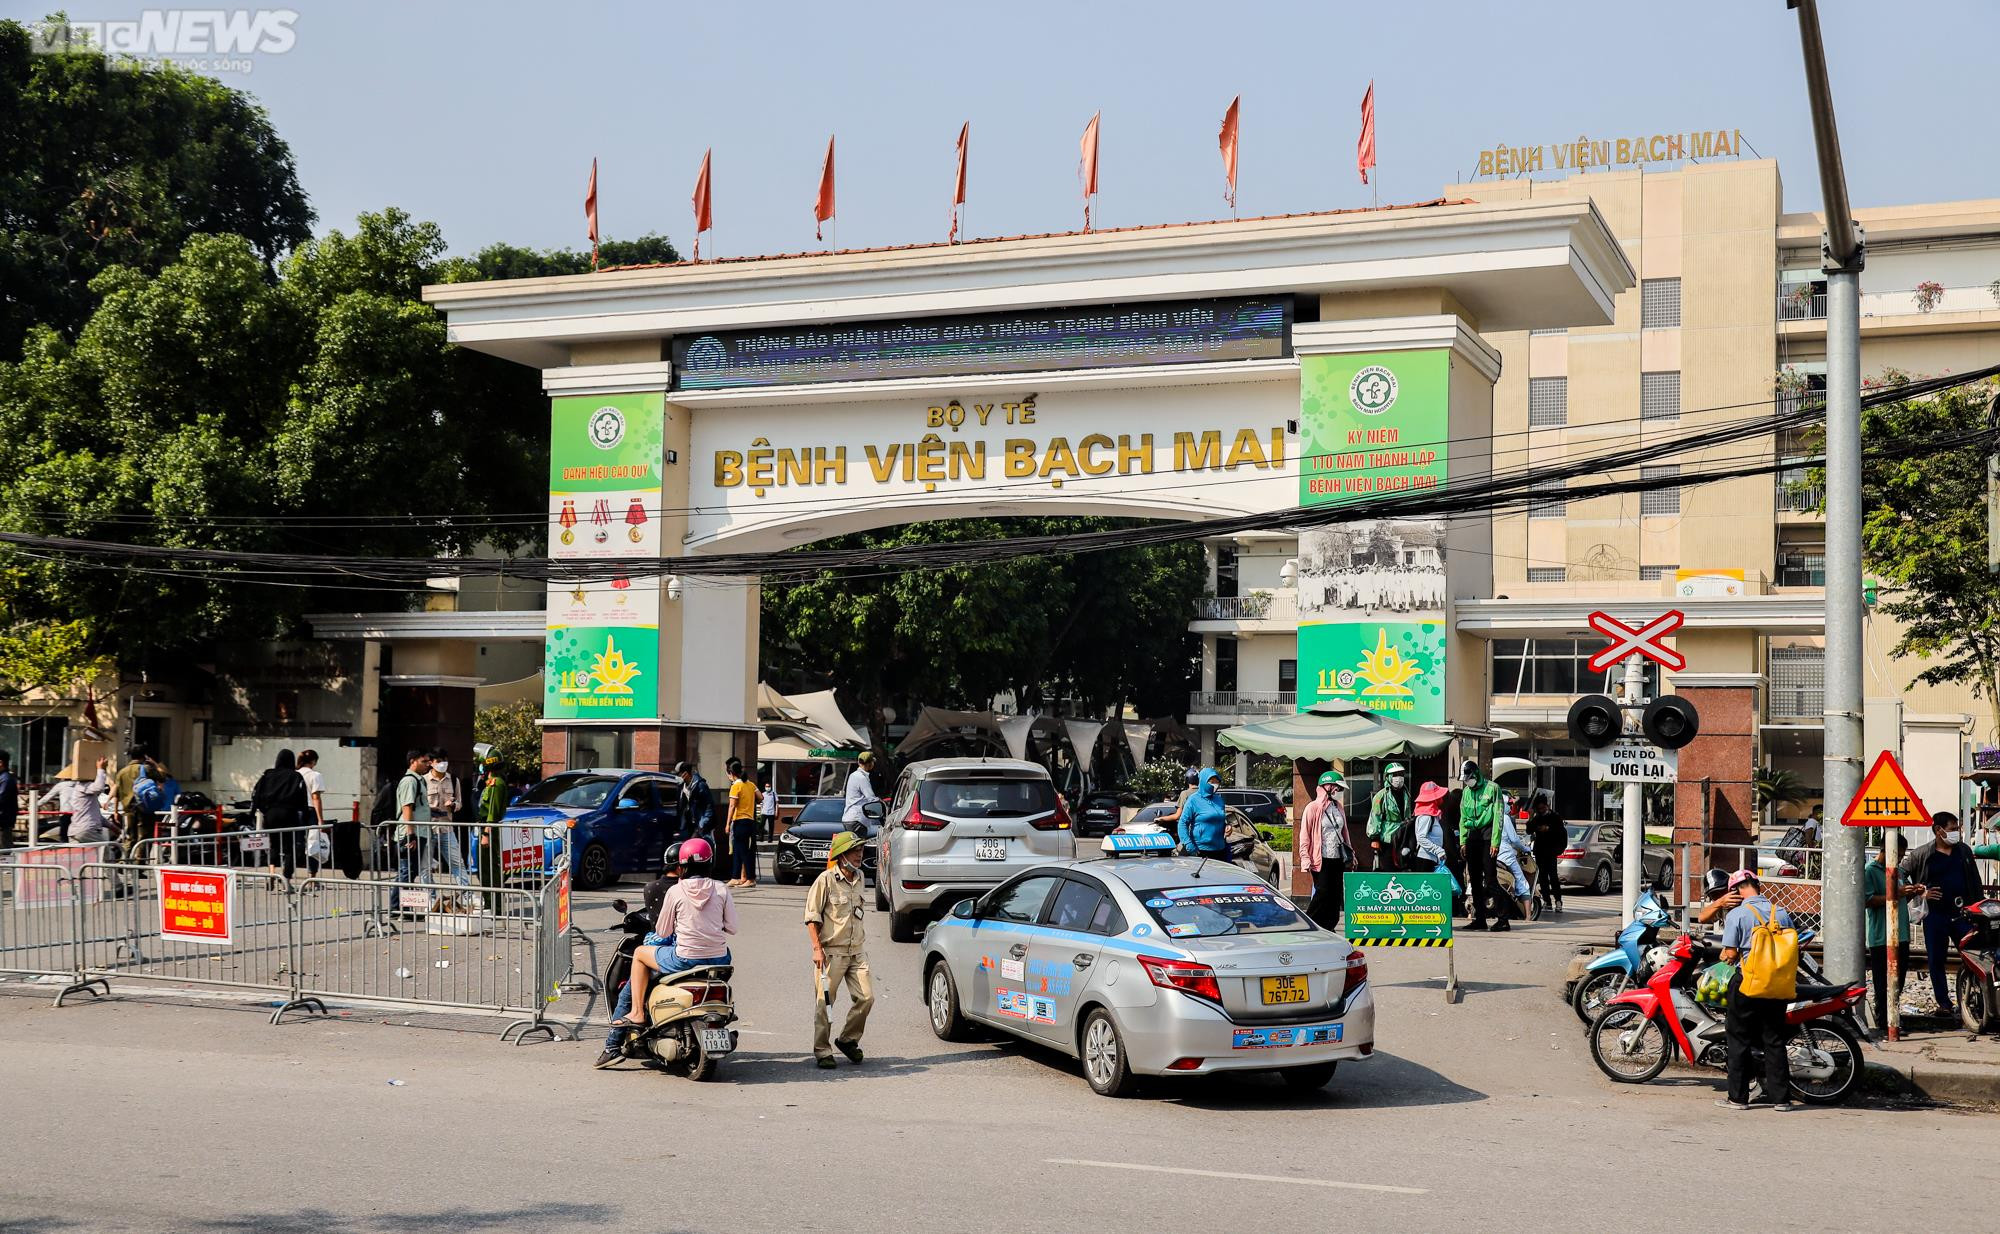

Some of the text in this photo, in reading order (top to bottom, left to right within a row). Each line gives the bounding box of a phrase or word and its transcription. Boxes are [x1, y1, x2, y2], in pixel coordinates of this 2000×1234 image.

[1480, 143, 1543, 179] BỆNH
[1551, 135, 1608, 173] VIỆN
[1690, 129, 1739, 158] MAI
[736, 308, 1214, 352] THÔNG BÁO PHÂN LUỒNG GIAO THÔNG TRONG BỆNH VIỆN
[927, 398, 1035, 432] BỘ Y TẾ
[1367, 427, 1398, 447] NIỆM
[714, 426, 1286, 497] BỆNH VIỆN BẠCH MAI
[1311, 455, 1333, 470] 110
[563, 467, 587, 480] DANH
[611, 465, 628, 478] CAO
[1309, 476, 1341, 496] BỆNH
[1345, 475, 1373, 495] VIỆN
[1389, 698, 1414, 711] VỮNG
[1644, 764, 1664, 780] LẠI
[982, 839, 998, 848] 30G
[1116, 836, 1135, 848] TAXI
[1155, 835, 1171, 847] ANH
[976, 849, 1005, 859] 443.29
[1367, 904, 1382, 912] MÁY
[1411, 904, 1431, 912] LÒNG
[1276, 977, 1296, 989] 30E
[1268, 989, 1305, 1003] 767.72
[705, 1031, 726, 1040] 29-S6
